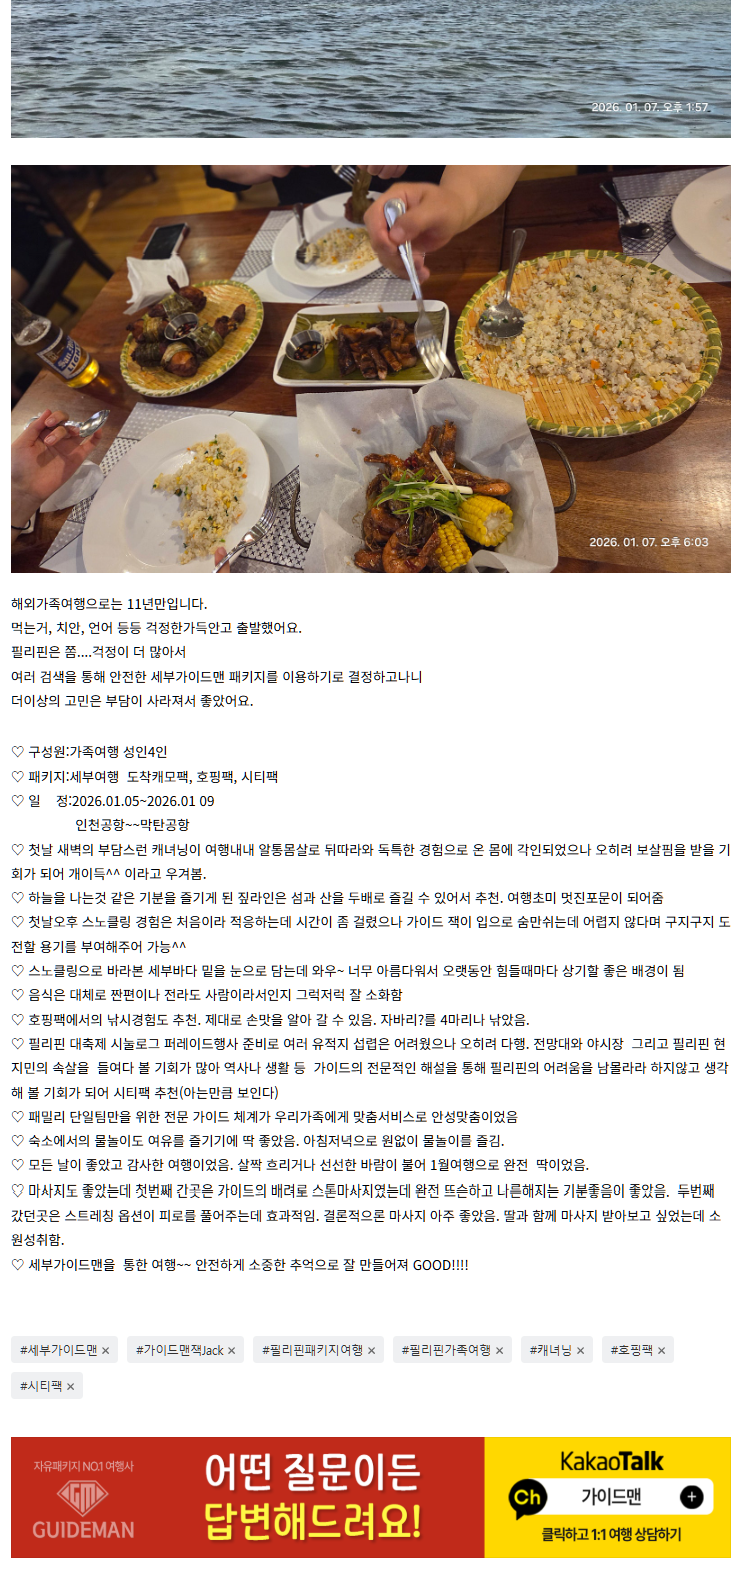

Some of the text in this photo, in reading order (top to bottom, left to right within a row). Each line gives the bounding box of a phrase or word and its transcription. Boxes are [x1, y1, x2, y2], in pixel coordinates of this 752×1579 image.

[10, 597, 207, 610] 해외가족여행으로는 11년만입니다.
[11, 621, 301, 635] 먹는거, 치안, 언어 등등 걱정한가득안고 출발했어요.
[11, 645, 185, 658] 필리핀은 쫌....걱정이 더 많아서
[11, 670, 421, 683] 여러 검색을 통해 안전한 세부가이드맨 패키지를 이용하기로 결정하고나니
[11, 694, 253, 707] 더이상의 고민은 부담이 사라져서 좋았어요.
[28, 745, 167, 758] 구성원:가족여행 성인4인
[28, 770, 277, 784] 패키지:세부여행 도착캐모팩, 호핑팩, 시티팩
[28, 794, 214, 807] 일 정:2026.01.05~2026.01 09
[75, 818, 190, 831] 인천공항~~막탄공항
[11, 867, 206, 880] 회가 되어 개이득^^ 이라고 우겨봄.
[11, 940, 186, 953] 전할 용기를 부여해주어 가능^^
[28, 988, 403, 1001] 음식은 대체로 짠편이나 전라도 사람이라서인지 그럭저럭 잘 소화함
[10, 1085, 278, 1100] 해 볼 기회가 되어 시티팩 추천(아는만큼 보인다)
[28, 1110, 518, 1123] 패밀리 단일팀만을 위한 전문 가이드 체계가 우리가족에게 맞춤서비스로 안성맞춤이었음
[28, 1134, 504, 1147] 숙소에서의 물놀이도 여유를 즐기기에 딱 좋았음. 아침저녁으로 원없이 물놀이를 즐김.
[10, 1233, 64, 1246] 원성취함.
[28, 1258, 468, 1271] 세부가이드맨을 통한 여행~~ 안전하게 소중한 추억으로 잘 만들어져 GOOD!!!!
[19, 1344, 97, 1356] #세부가이드맨
[135, 1344, 224, 1356] #가이드맨잭Jack
[261, 1343, 362, 1356] #필리핀패키지여행
[401, 1343, 490, 1356] #필리핀가족여행
[529, 1344, 571, 1356] #캐녀닝
[610, 1344, 652, 1356] #호핑팩
[19, 1380, 61, 1392] #시티팩
[33, 1460, 134, 1472] 자유패키지 NO.1 여행사
[561, 1450, 664, 1471] KakaoTalk
[205, 1453, 422, 1492] 어떤 질문이든
[514, 1489, 541, 1505] Ch
[582, 1487, 642, 1506] 가이드맨
[204, 1502, 422, 1542] 답변해드려요!
[32, 1521, 135, 1539] GUIDEMAN
[542, 1527, 682, 1542] 클릭하고 1:1 여행 상담하기
